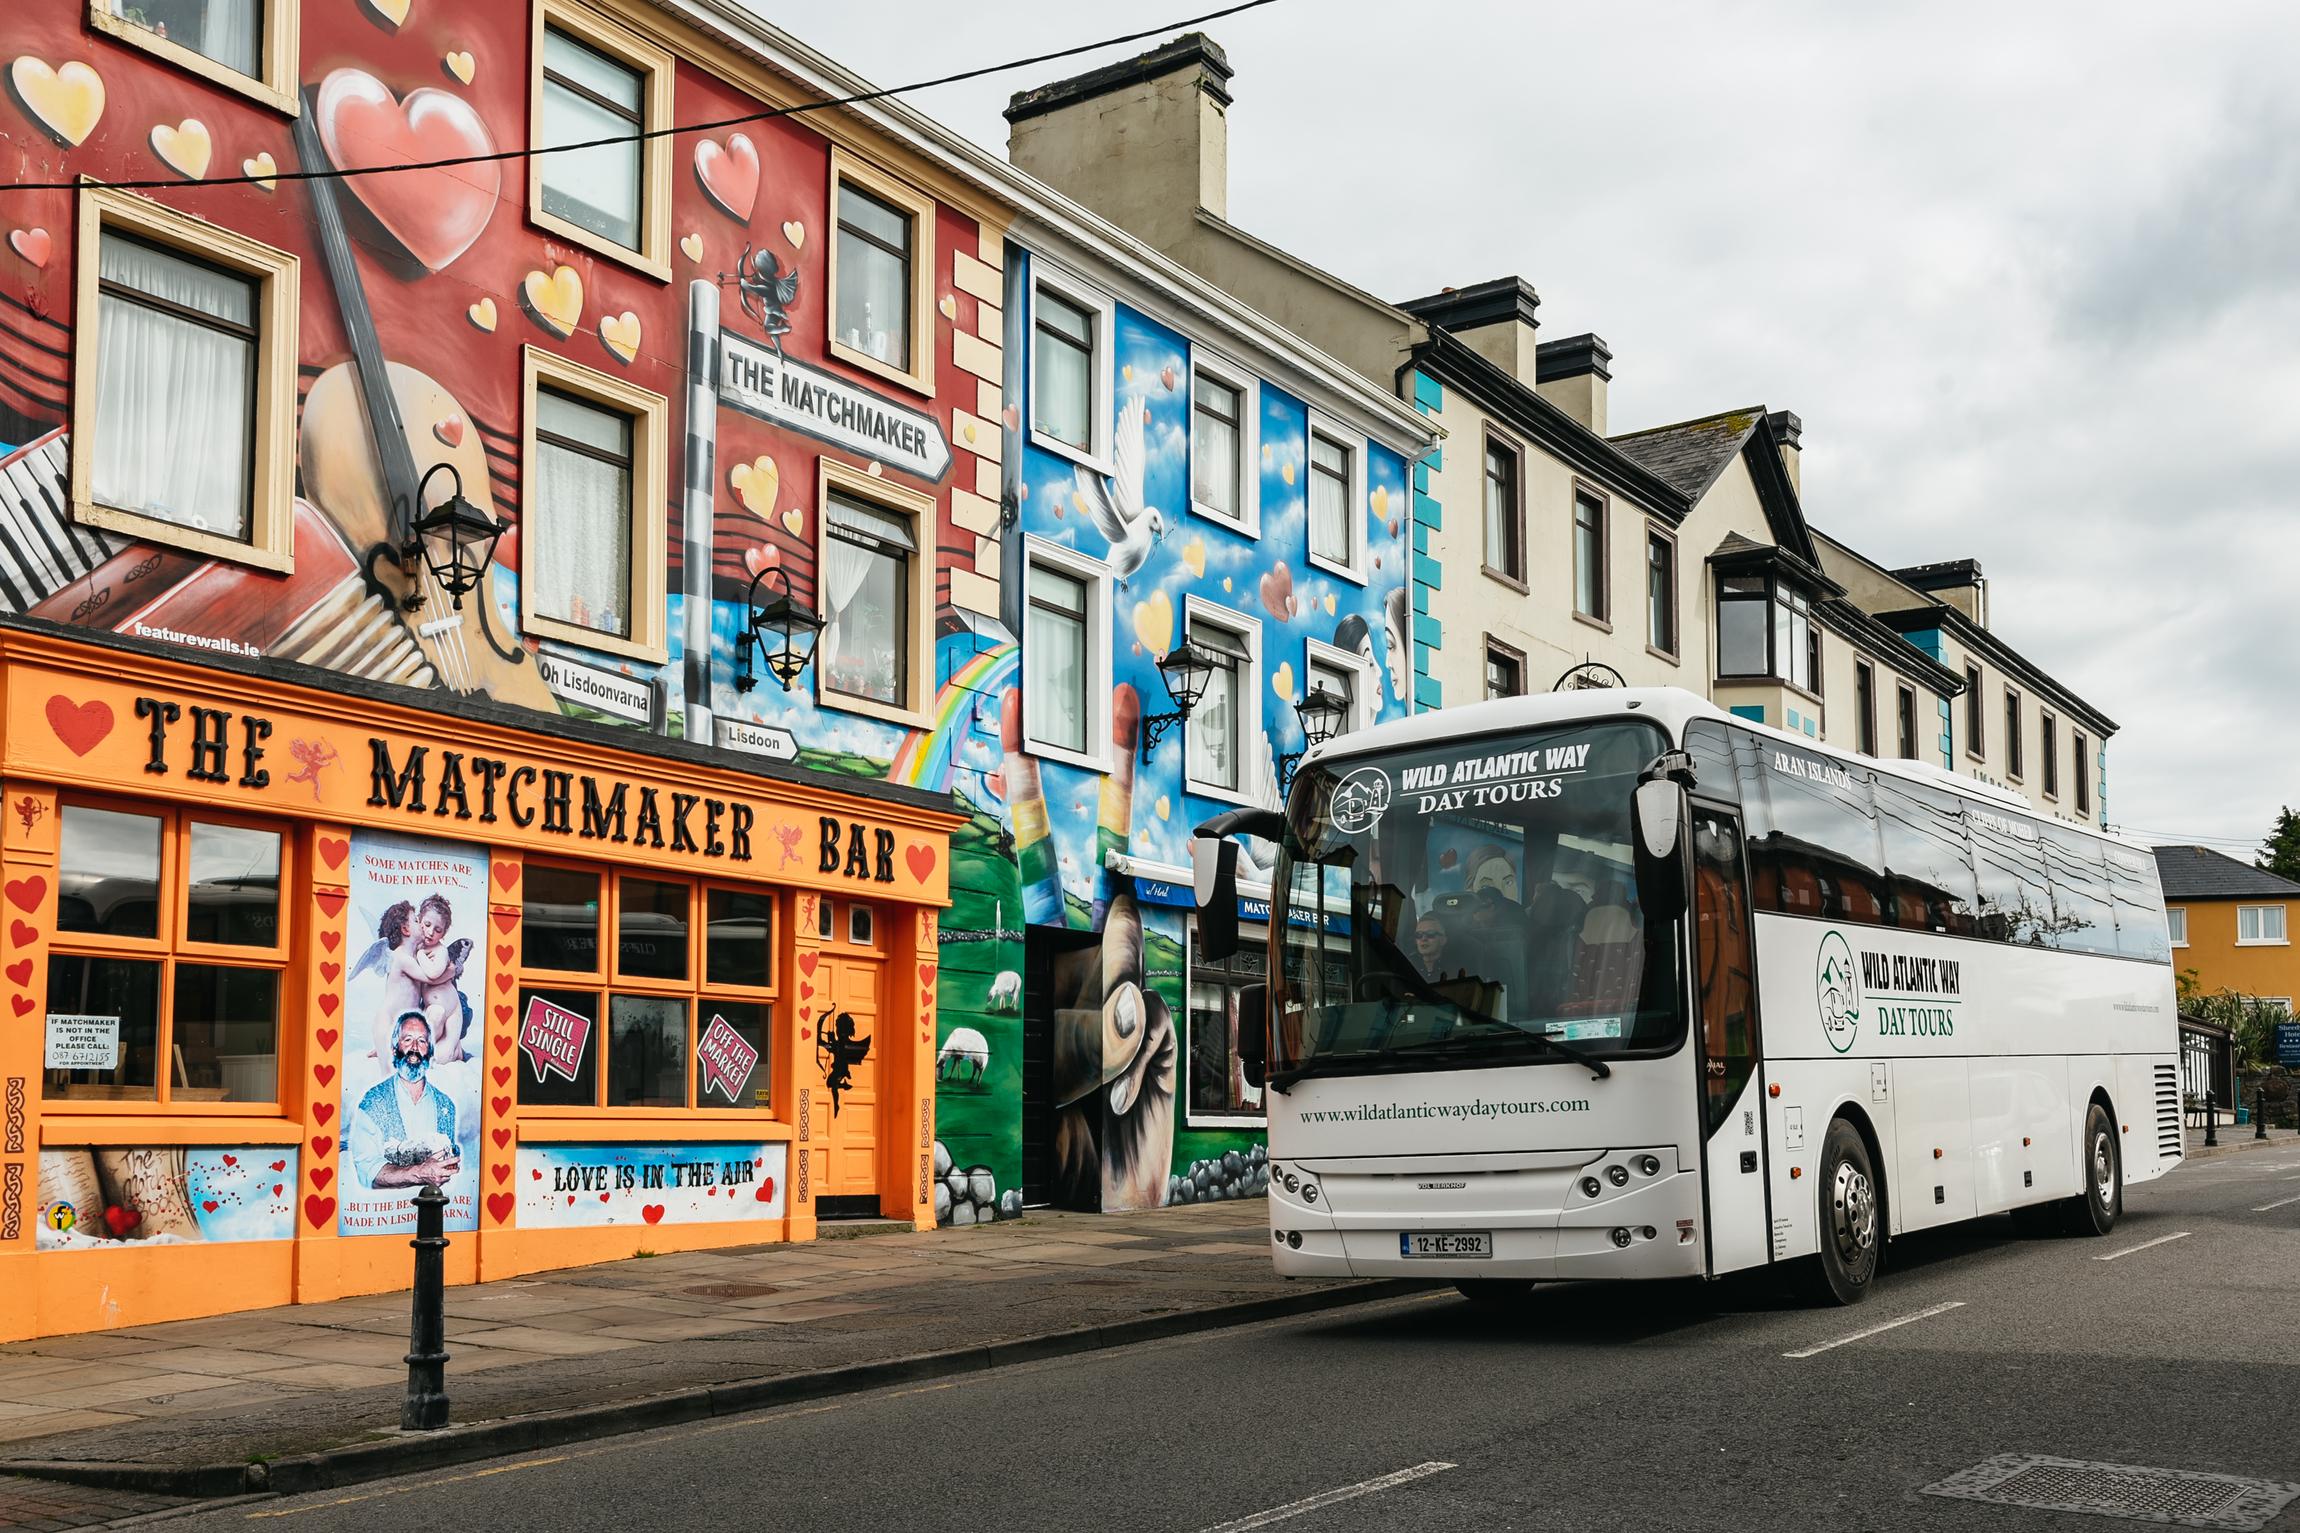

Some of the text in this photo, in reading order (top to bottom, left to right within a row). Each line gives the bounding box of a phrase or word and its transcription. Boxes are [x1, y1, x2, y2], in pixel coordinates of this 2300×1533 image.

[728, 350, 928, 459] THE MATCHMAKER
[134, 621, 260, 656] featurewalls.ie
[563, 666, 648, 712] Lisdoonvarna
[728, 726, 780, 750] Lisdoon
[1402, 744, 1590, 790] WILD ATLANTIC WAY
[1774, 751, 1851, 790] ARAN ISLANDS
[135, 697, 896, 884] THE MATCHMAKER BAR
[1417, 778, 1563, 815] DAY TOURS
[364, 855, 472, 876] SOME MATCHES ARE
[368, 871, 399, 885] MADE
[402, 875, 413, 885] IN
[1861, 951, 1960, 994] WILD ATLANTIC WAY
[542, 1008, 574, 1041] STILL
[1878, 1006, 1953, 1037] DAY TOURS
[52, 1051, 69, 1060] 087
[527, 1025, 577, 1065] SINGLE
[703, 1038, 744, 1086] MARKET
[714, 1023, 751, 1071] OFF THE
[1300, 1099, 1590, 1124] www.wildatlanticwaydaytours.com
[554, 1159, 754, 1192] LOVE IS IN THE AIR
[373, 1201, 393, 1211] THE
[396, 1199, 415, 1210] BES
[453, 1195, 472, 1205] ARE
[343, 1215, 374, 1227] MADE
[377, 1216, 388, 1226] IN
[1417, 1237, 1482, 1252] 12-KE-2992
